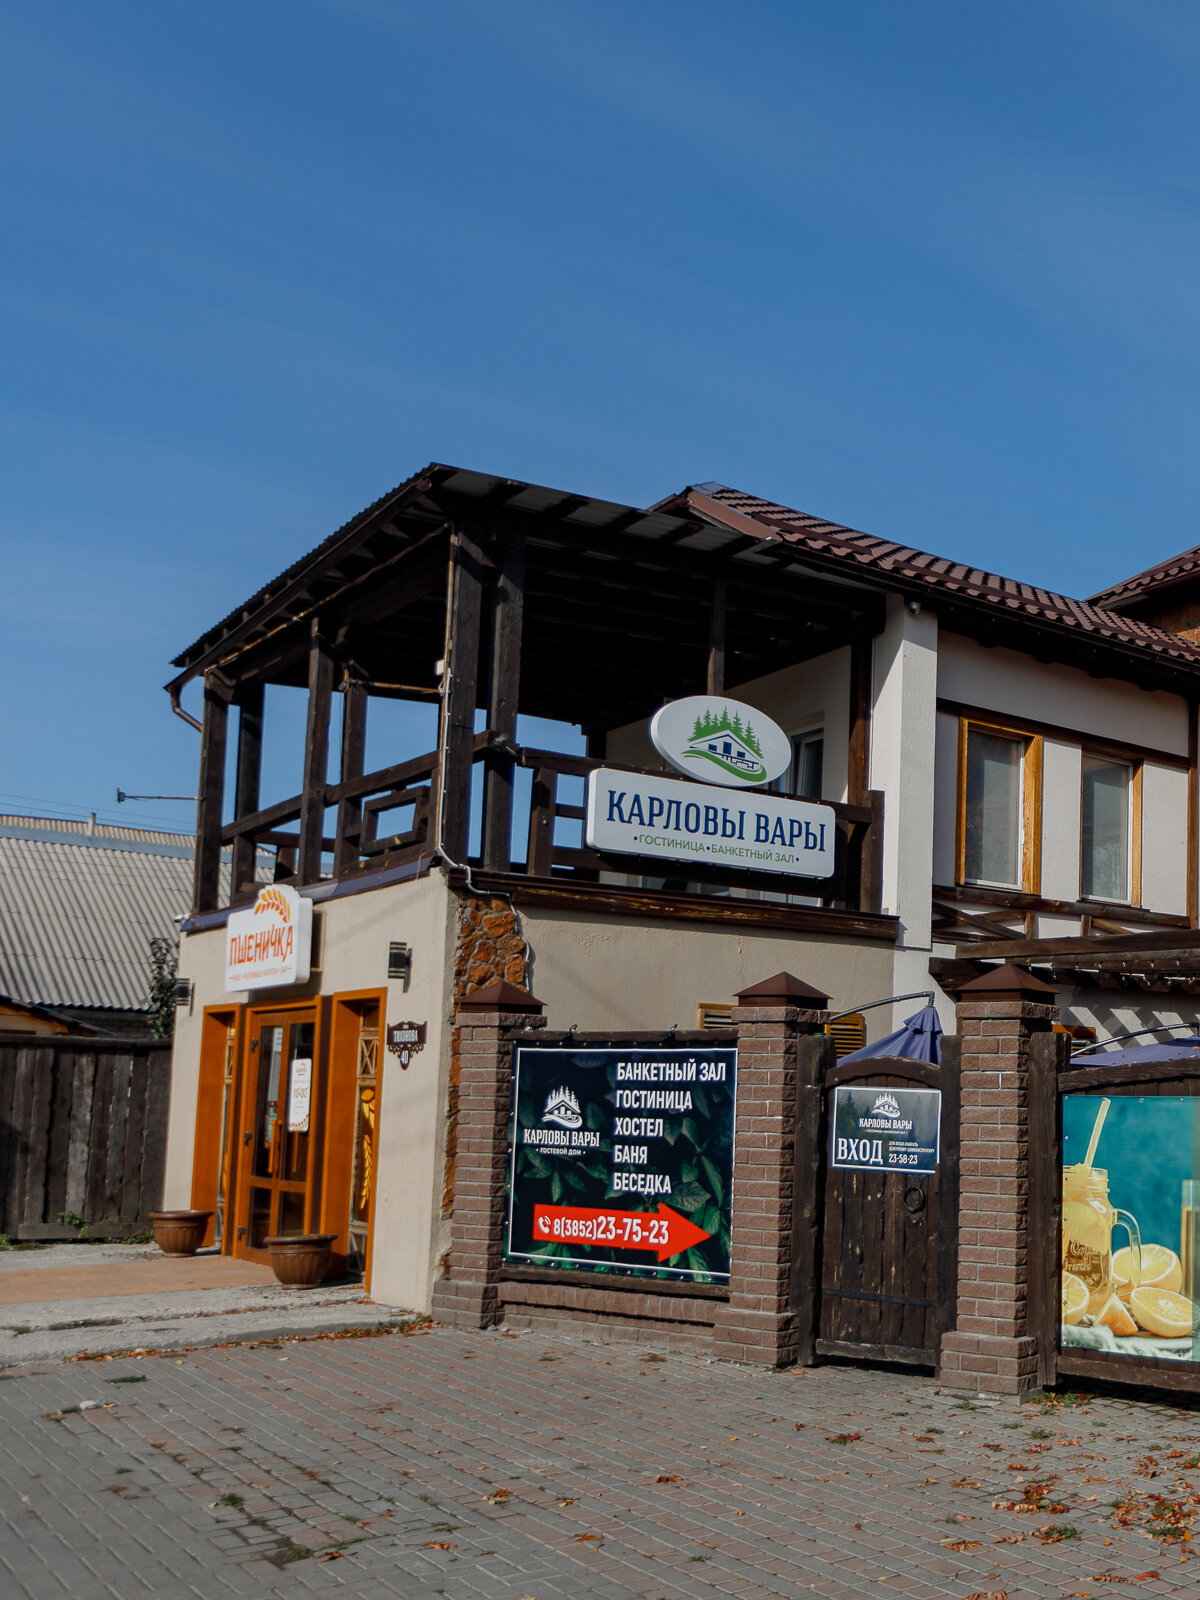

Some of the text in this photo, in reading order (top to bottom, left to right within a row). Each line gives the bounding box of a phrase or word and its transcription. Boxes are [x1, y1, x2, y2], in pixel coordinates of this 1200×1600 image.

[607, 790, 826, 852] КАРЛОВЫ ВАРЫ
[639, 834, 794, 863] ГОСТИНИЦА БАНКЕТНЫЙ ЗАЛ
[229, 924, 293, 966] ПШЕНИЧКА
[617, 1058, 726, 1082] БАНКЕТНЫЙ ЗАЛ
[615, 1090, 693, 1112] ГОСТИНИЦА
[614, 1118, 664, 1138] ХОСТЕЛ
[859, 1118, 912, 1130] КАРЛОВЫ ВАРЫ
[523, 1128, 600, 1147] КАРЛОВЫ ВАРЫ
[540, 1147, 567, 1155] ГОСТЕВОЙ
[614, 1145, 648, 1164] БАНЯ
[837, 1138, 883, 1165] ВХОД
[613, 1172, 672, 1195] БЕСЕДКА
[553, 1216, 669, 1245] 8(3852)23-75-23
